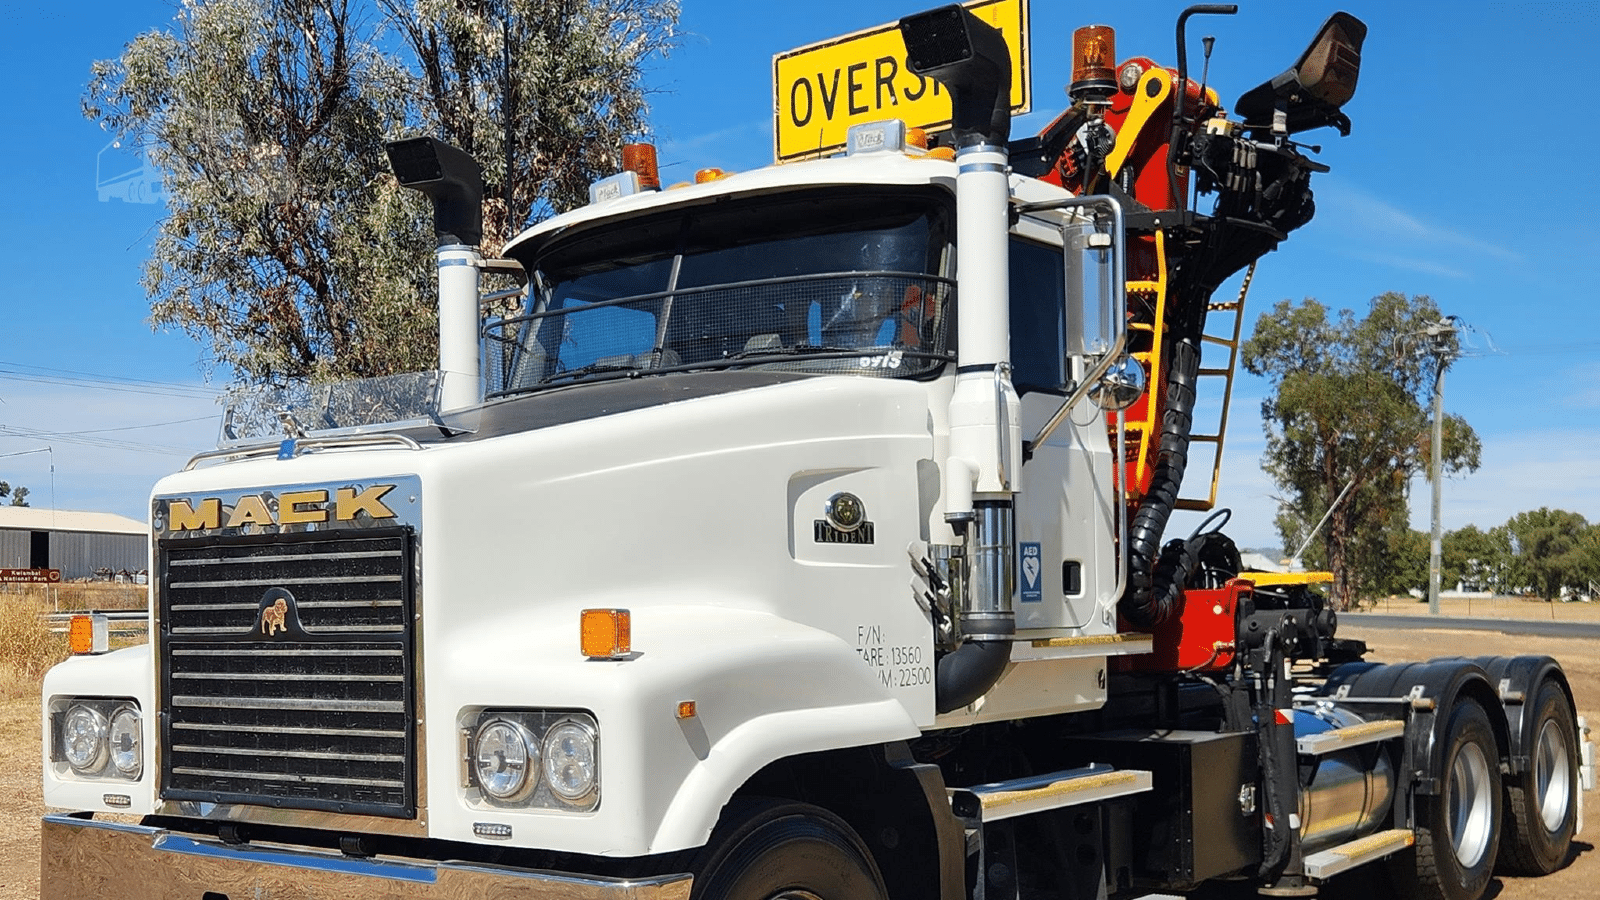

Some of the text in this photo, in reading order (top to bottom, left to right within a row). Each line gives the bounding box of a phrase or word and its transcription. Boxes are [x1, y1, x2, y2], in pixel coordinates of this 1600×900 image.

[791, 53, 946, 127] OVERS
[169, 484, 398, 531] MACK
[815, 520, 874, 543] TRIDENT
[1023, 546, 1038, 556] AED
[891, 646, 922, 665] 13560
[899, 666, 932, 687] 22500
